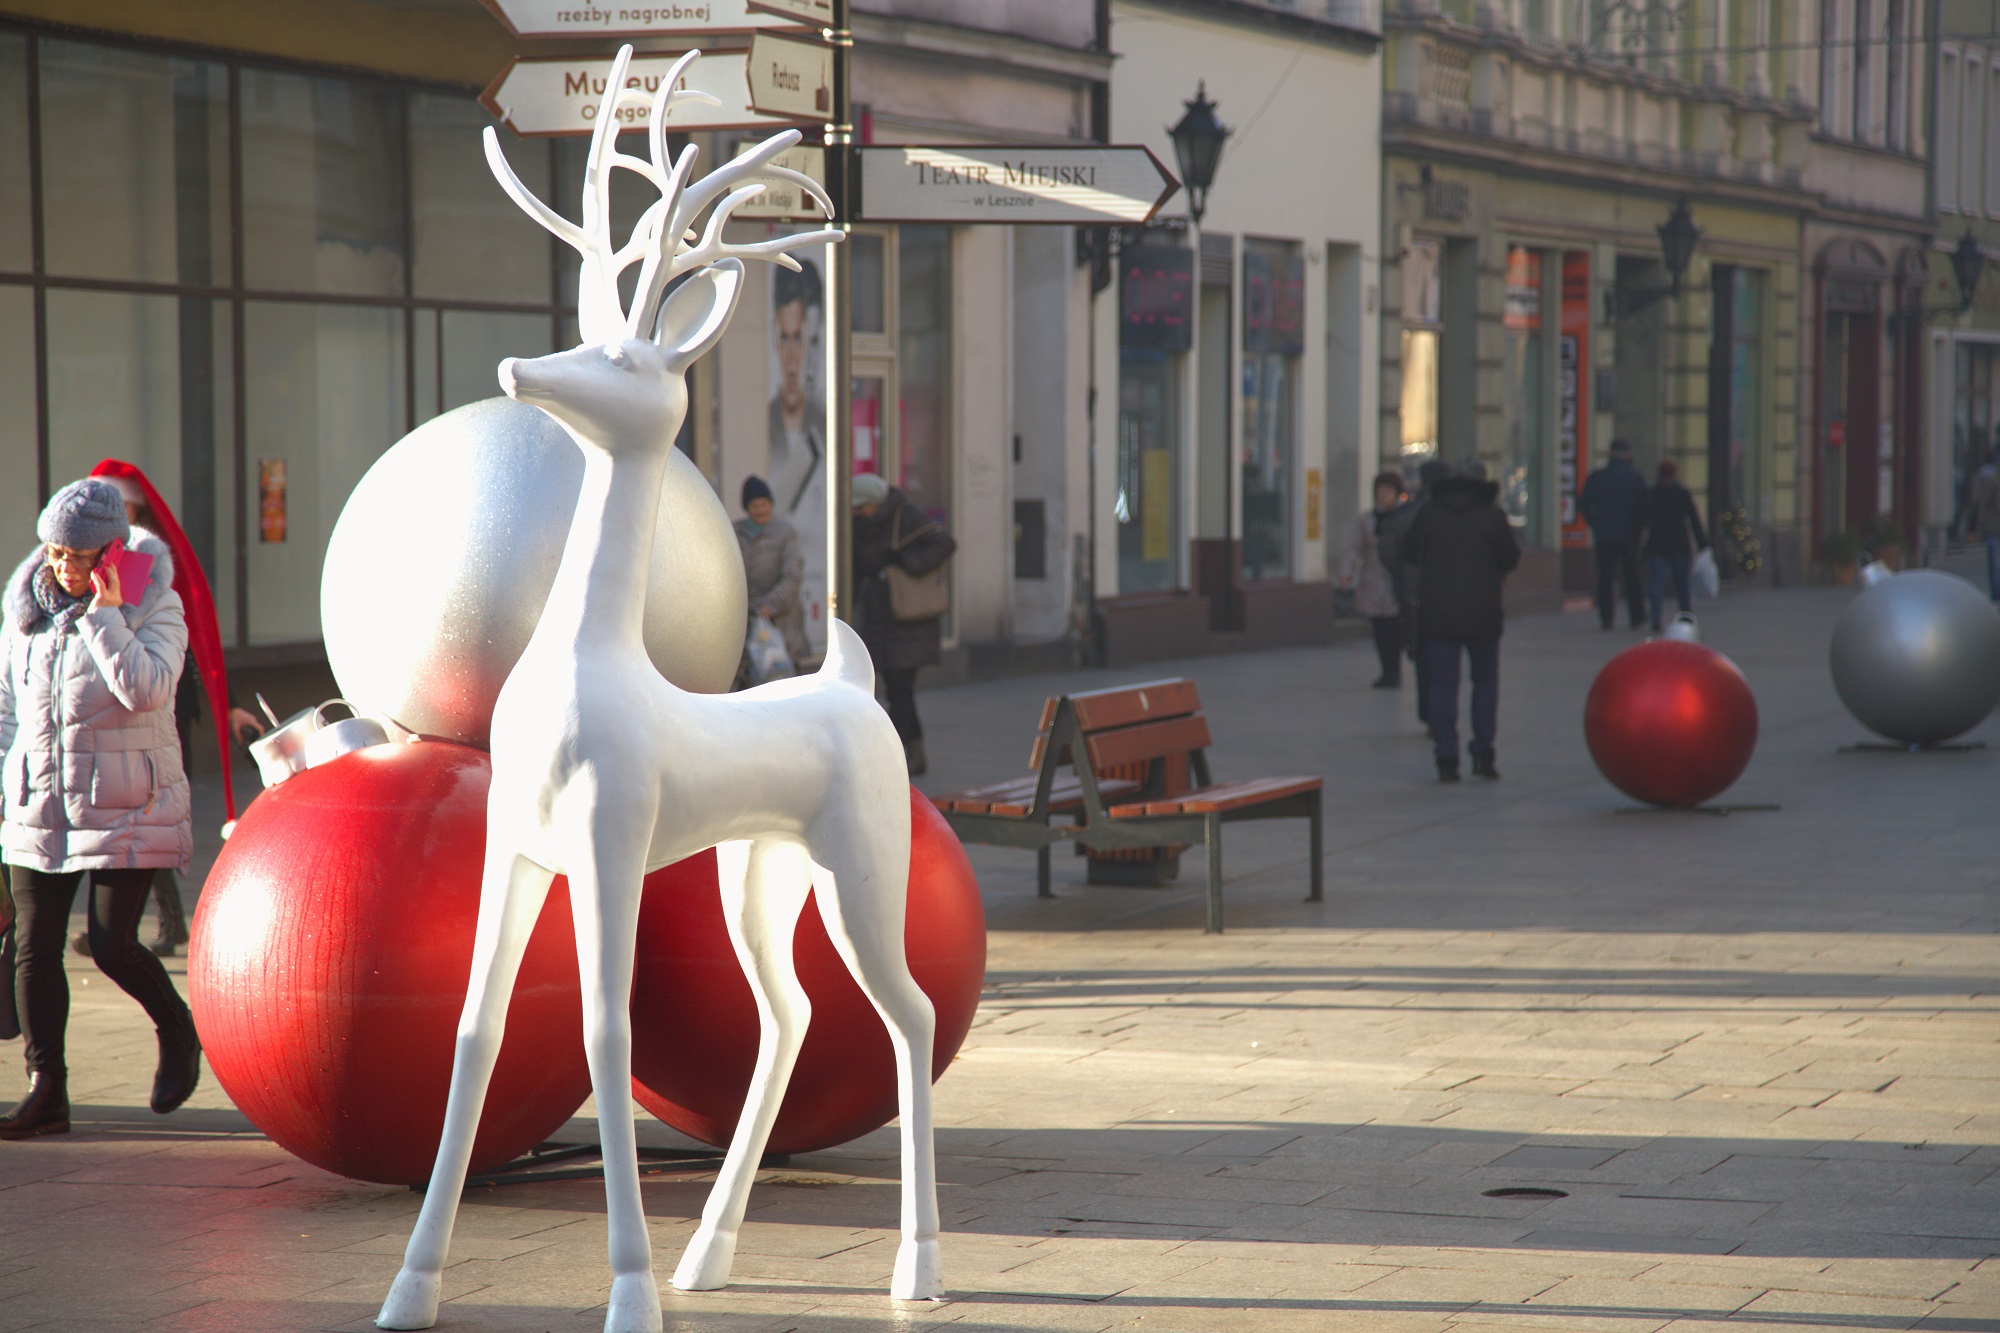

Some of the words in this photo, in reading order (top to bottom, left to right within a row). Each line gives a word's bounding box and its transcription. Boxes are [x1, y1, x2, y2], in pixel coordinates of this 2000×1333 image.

[619, 3, 711, 24] nagrobnej
[565, 71, 686, 96] Mueu
[772, 61, 799, 91] Ratusz
[912, 161, 990, 185] TEATR
[1003, 161, 1096, 187] MIEJSKI
[972, 196, 985, 207] w
[988, 194, 1035, 207] Lesznie
